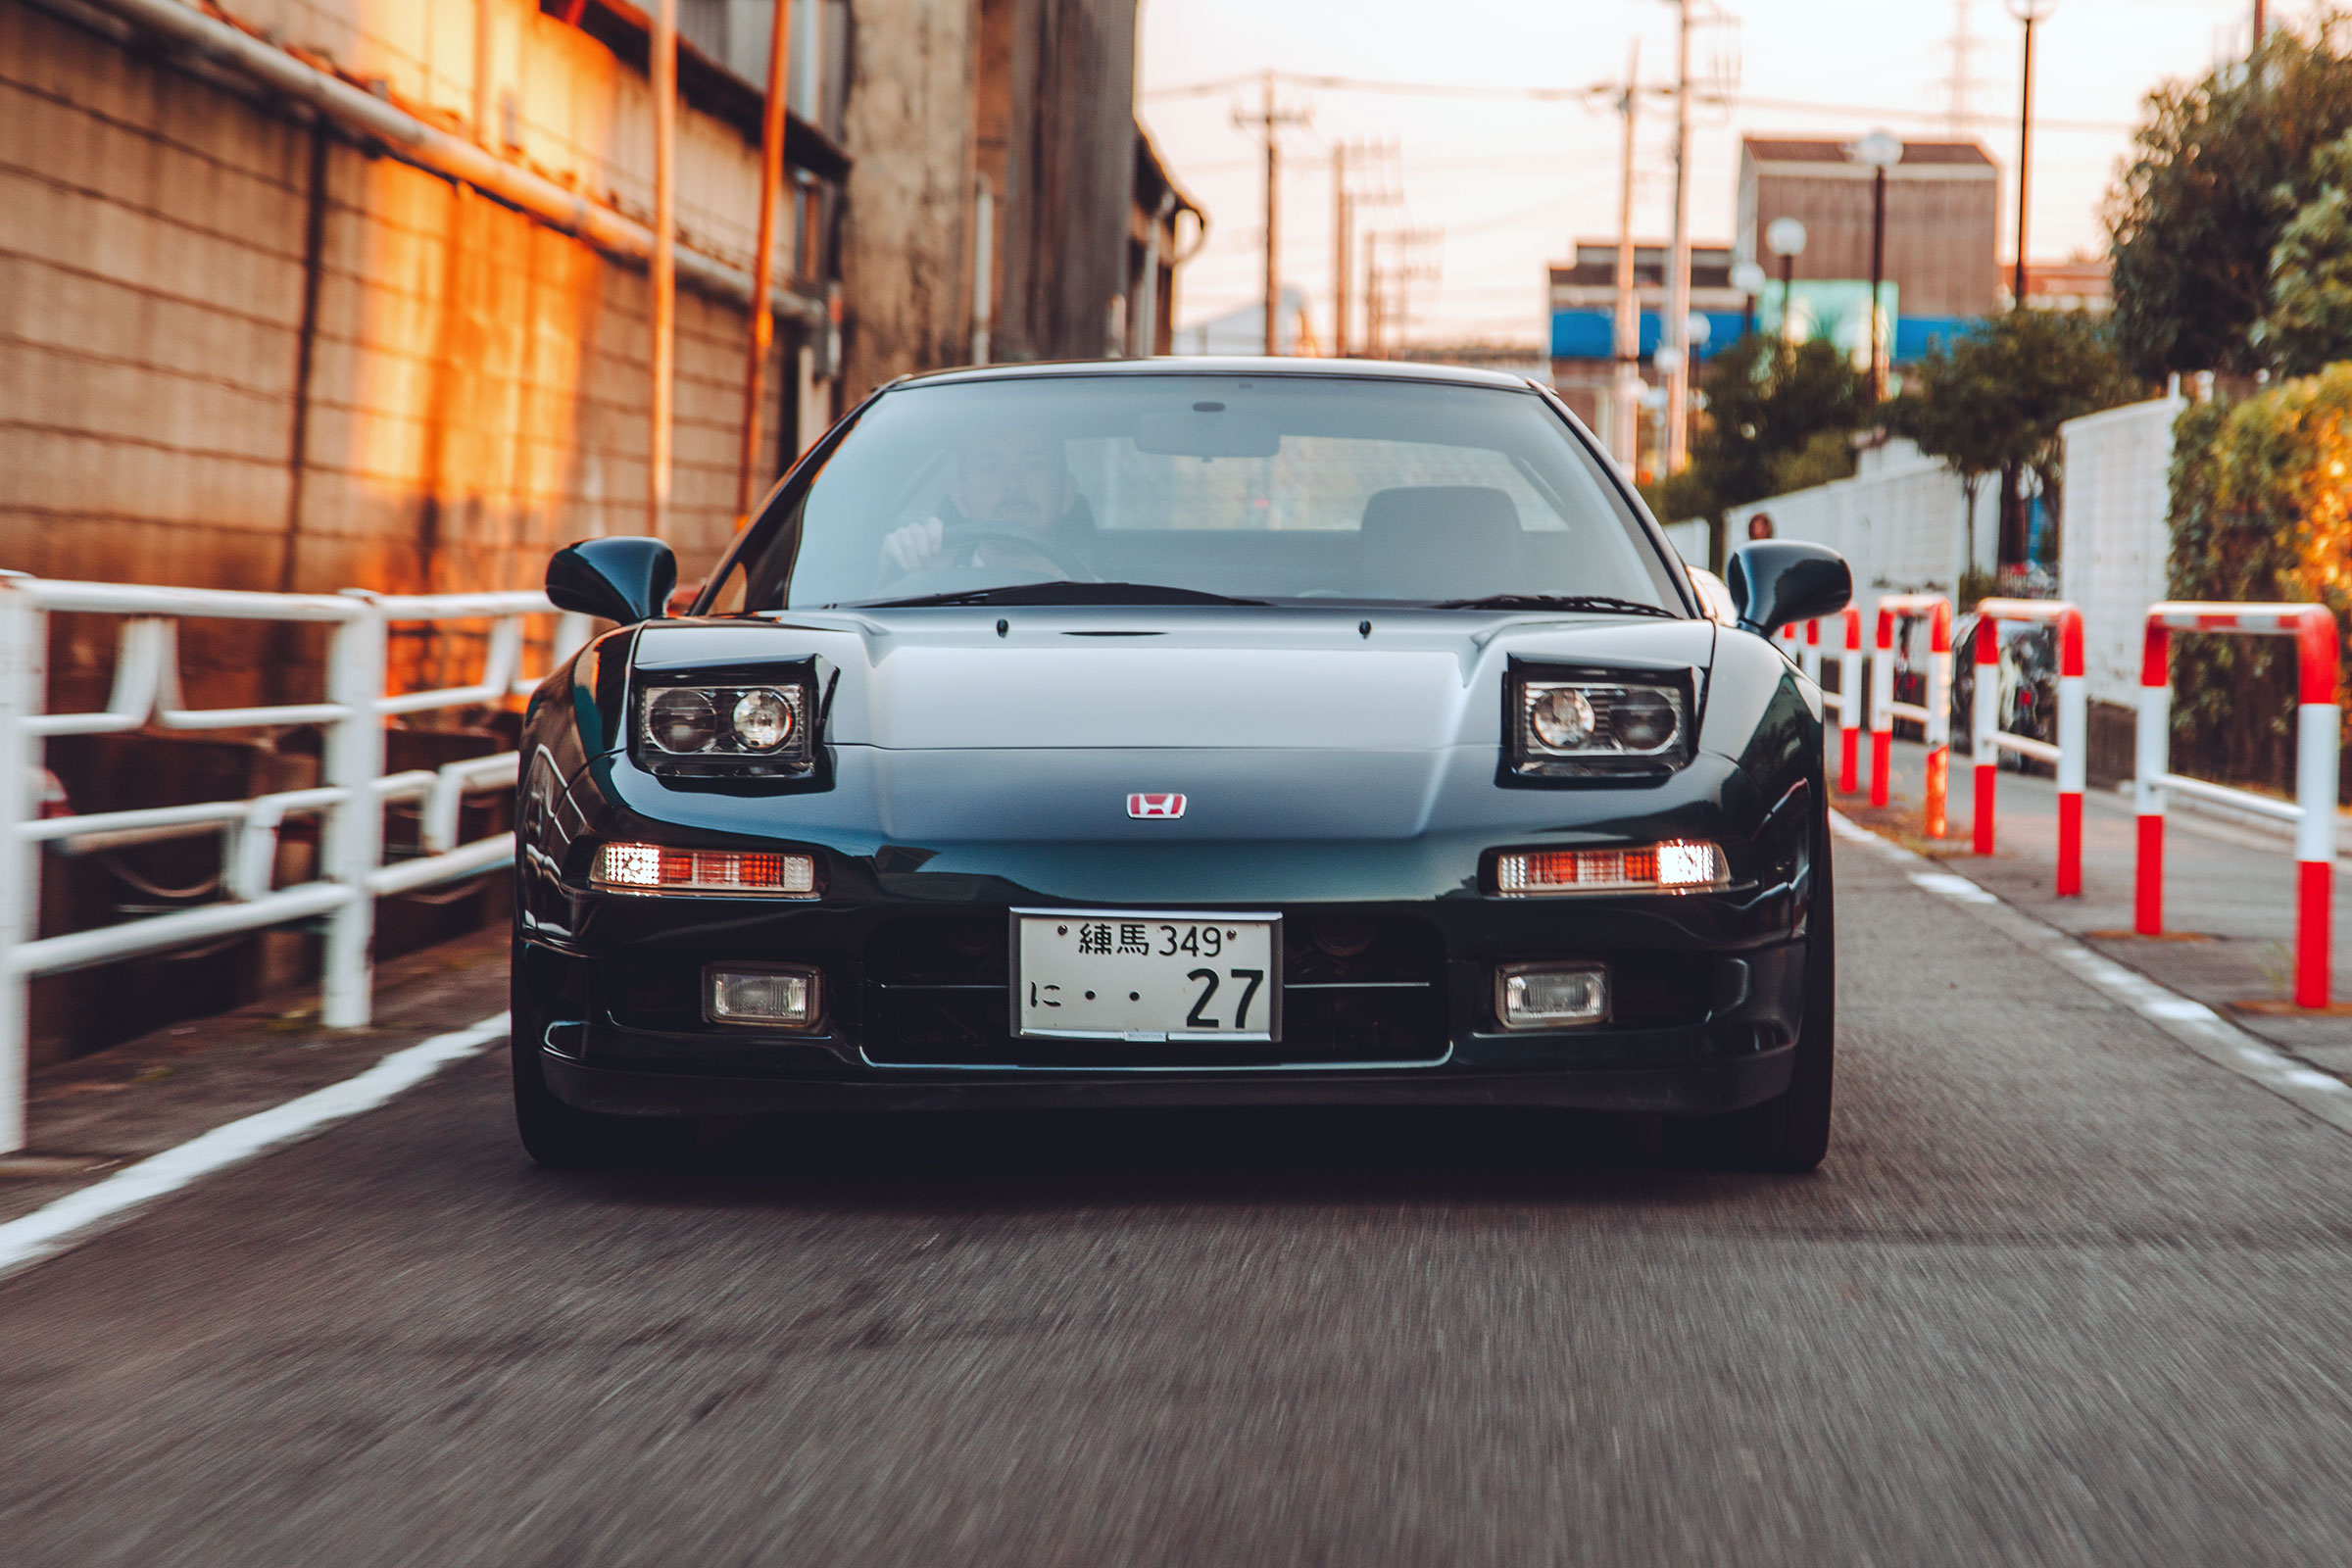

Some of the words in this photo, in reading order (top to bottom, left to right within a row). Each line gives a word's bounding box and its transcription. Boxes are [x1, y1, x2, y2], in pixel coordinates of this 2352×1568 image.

[1078, 923, 1150, 956] 練馬
[1158, 925, 1222, 957] 349
[1030, 981, 1062, 1008] に
